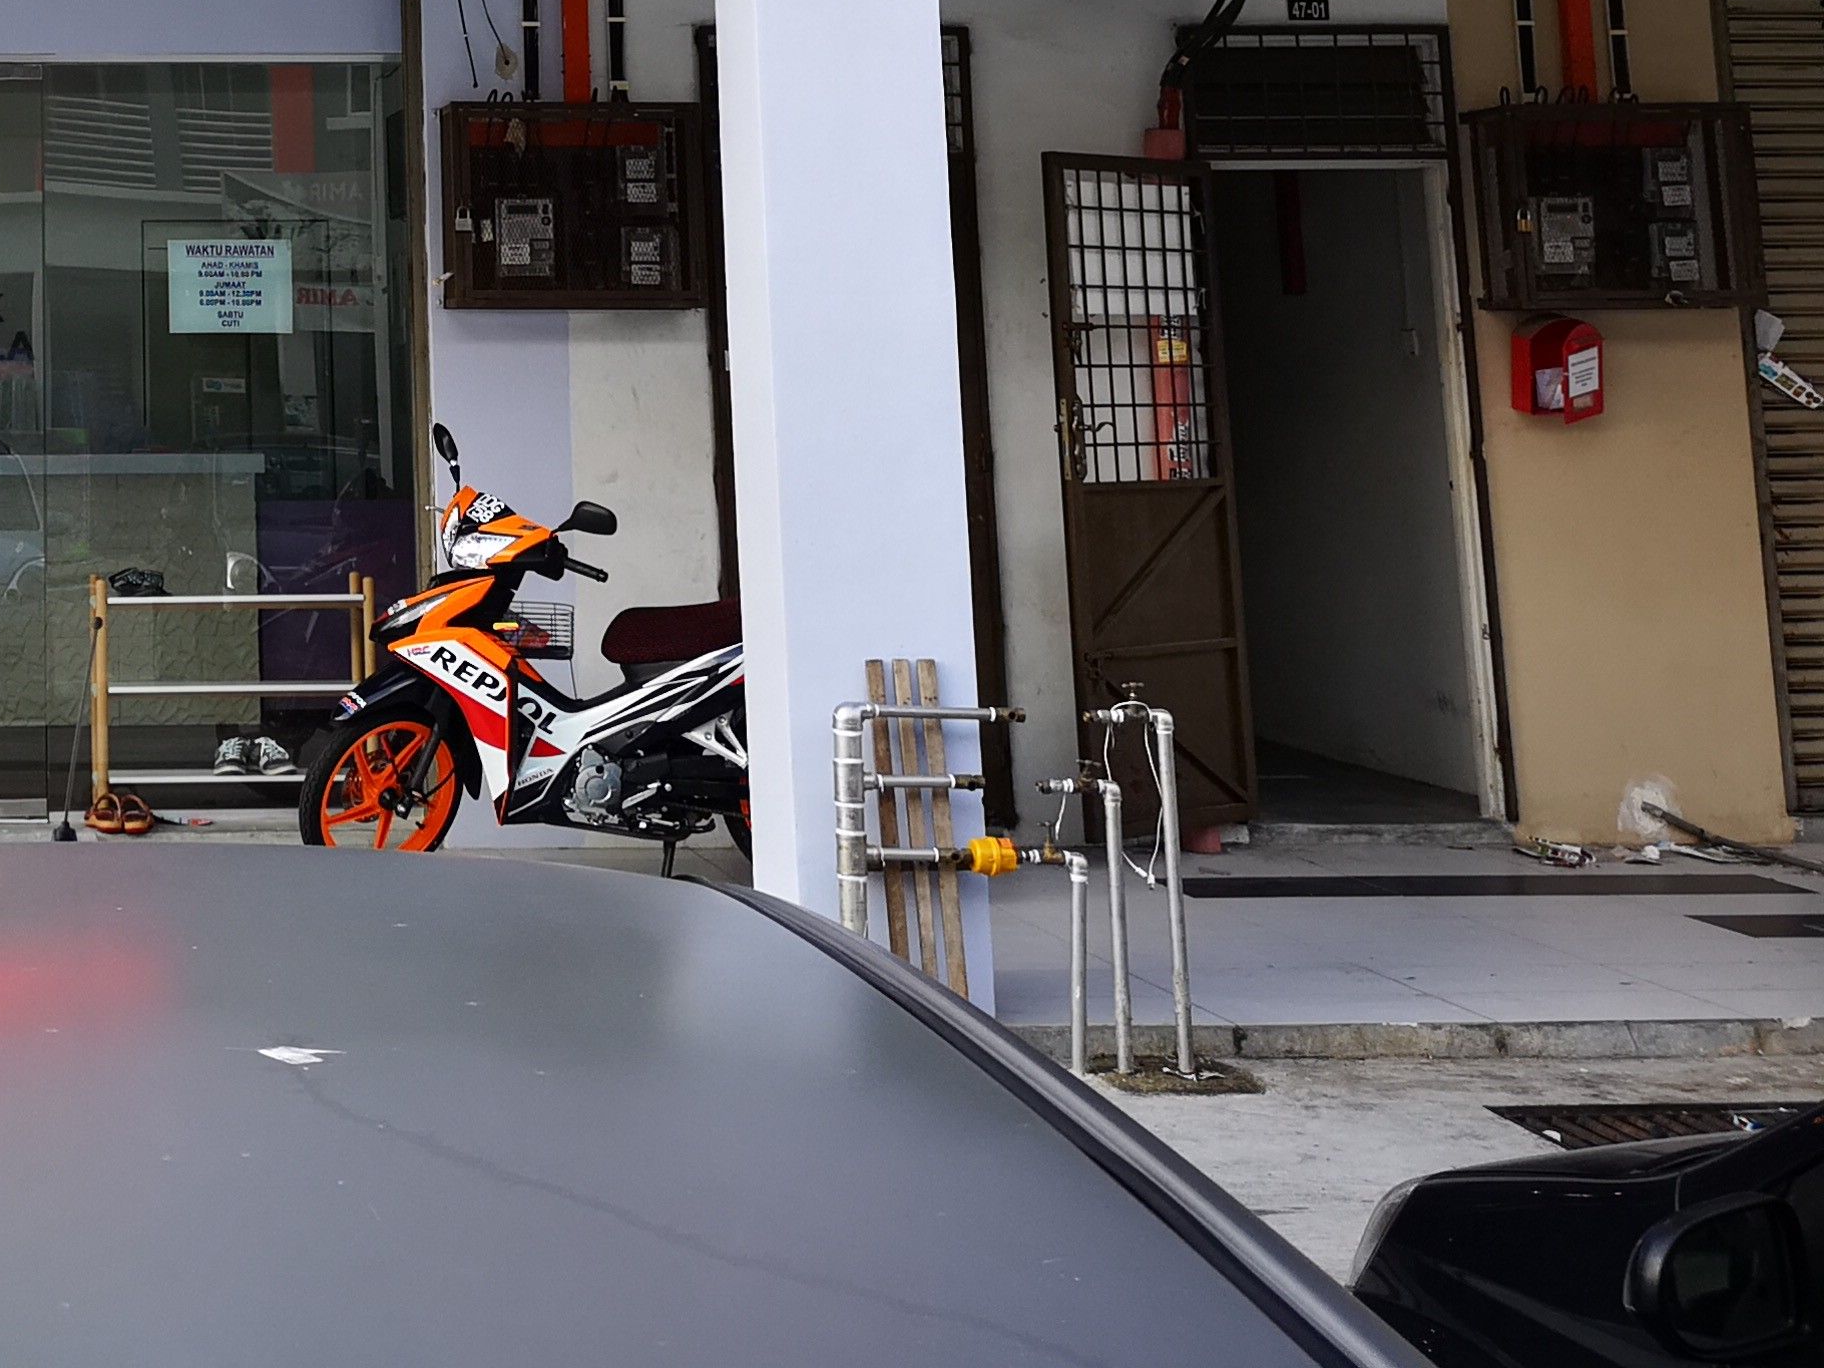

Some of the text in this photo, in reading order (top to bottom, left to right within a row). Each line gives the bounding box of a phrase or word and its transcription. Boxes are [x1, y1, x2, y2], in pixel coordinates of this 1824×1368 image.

[1292, 1, 1326, 18] 47-01
[185, 245, 275, 257] WAKTU RAWATAN
[221, 320, 241, 328] CUTI
